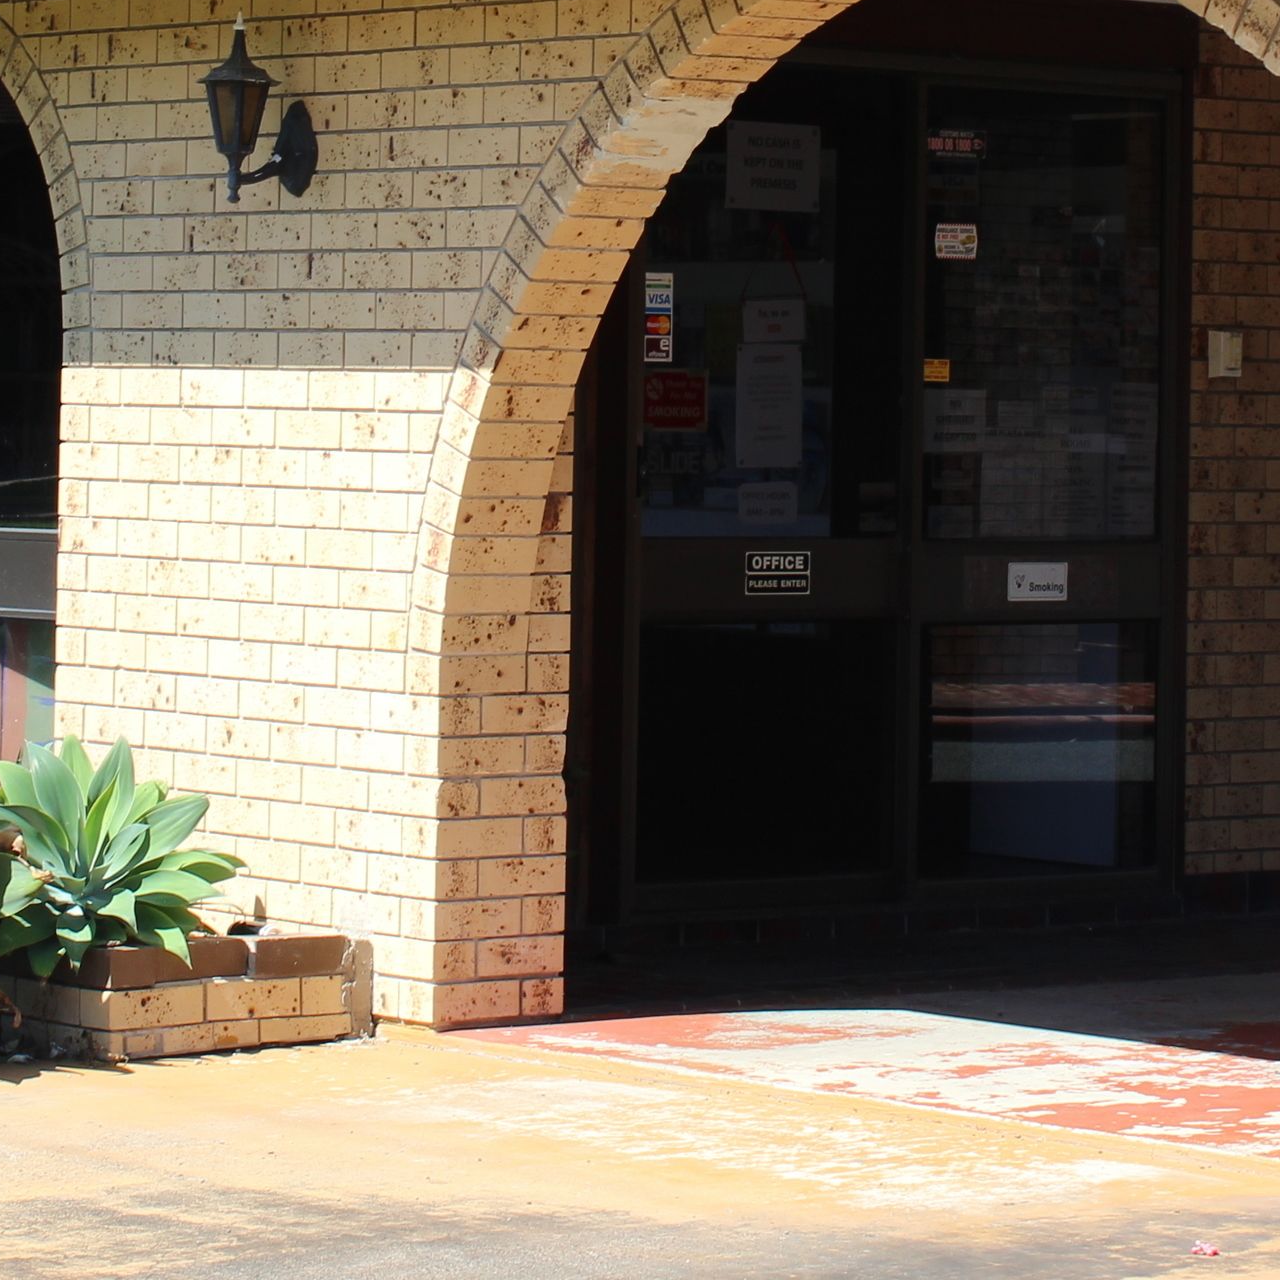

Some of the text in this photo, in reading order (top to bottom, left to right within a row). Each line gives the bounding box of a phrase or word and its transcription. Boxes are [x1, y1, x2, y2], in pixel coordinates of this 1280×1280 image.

[748, 136, 763, 147] NO
[765, 136, 790, 149] CASH
[744, 156, 803, 170] KEPT ON THE
[648, 294, 671, 304] VISA
[647, 406, 700, 417] SMOKING
[648, 449, 702, 475] SLIDE
[752, 556, 804, 569] OFFICE
[749, 579, 807, 588] PLEASE ENTER
[1029, 582, 1064, 594] Smoking
